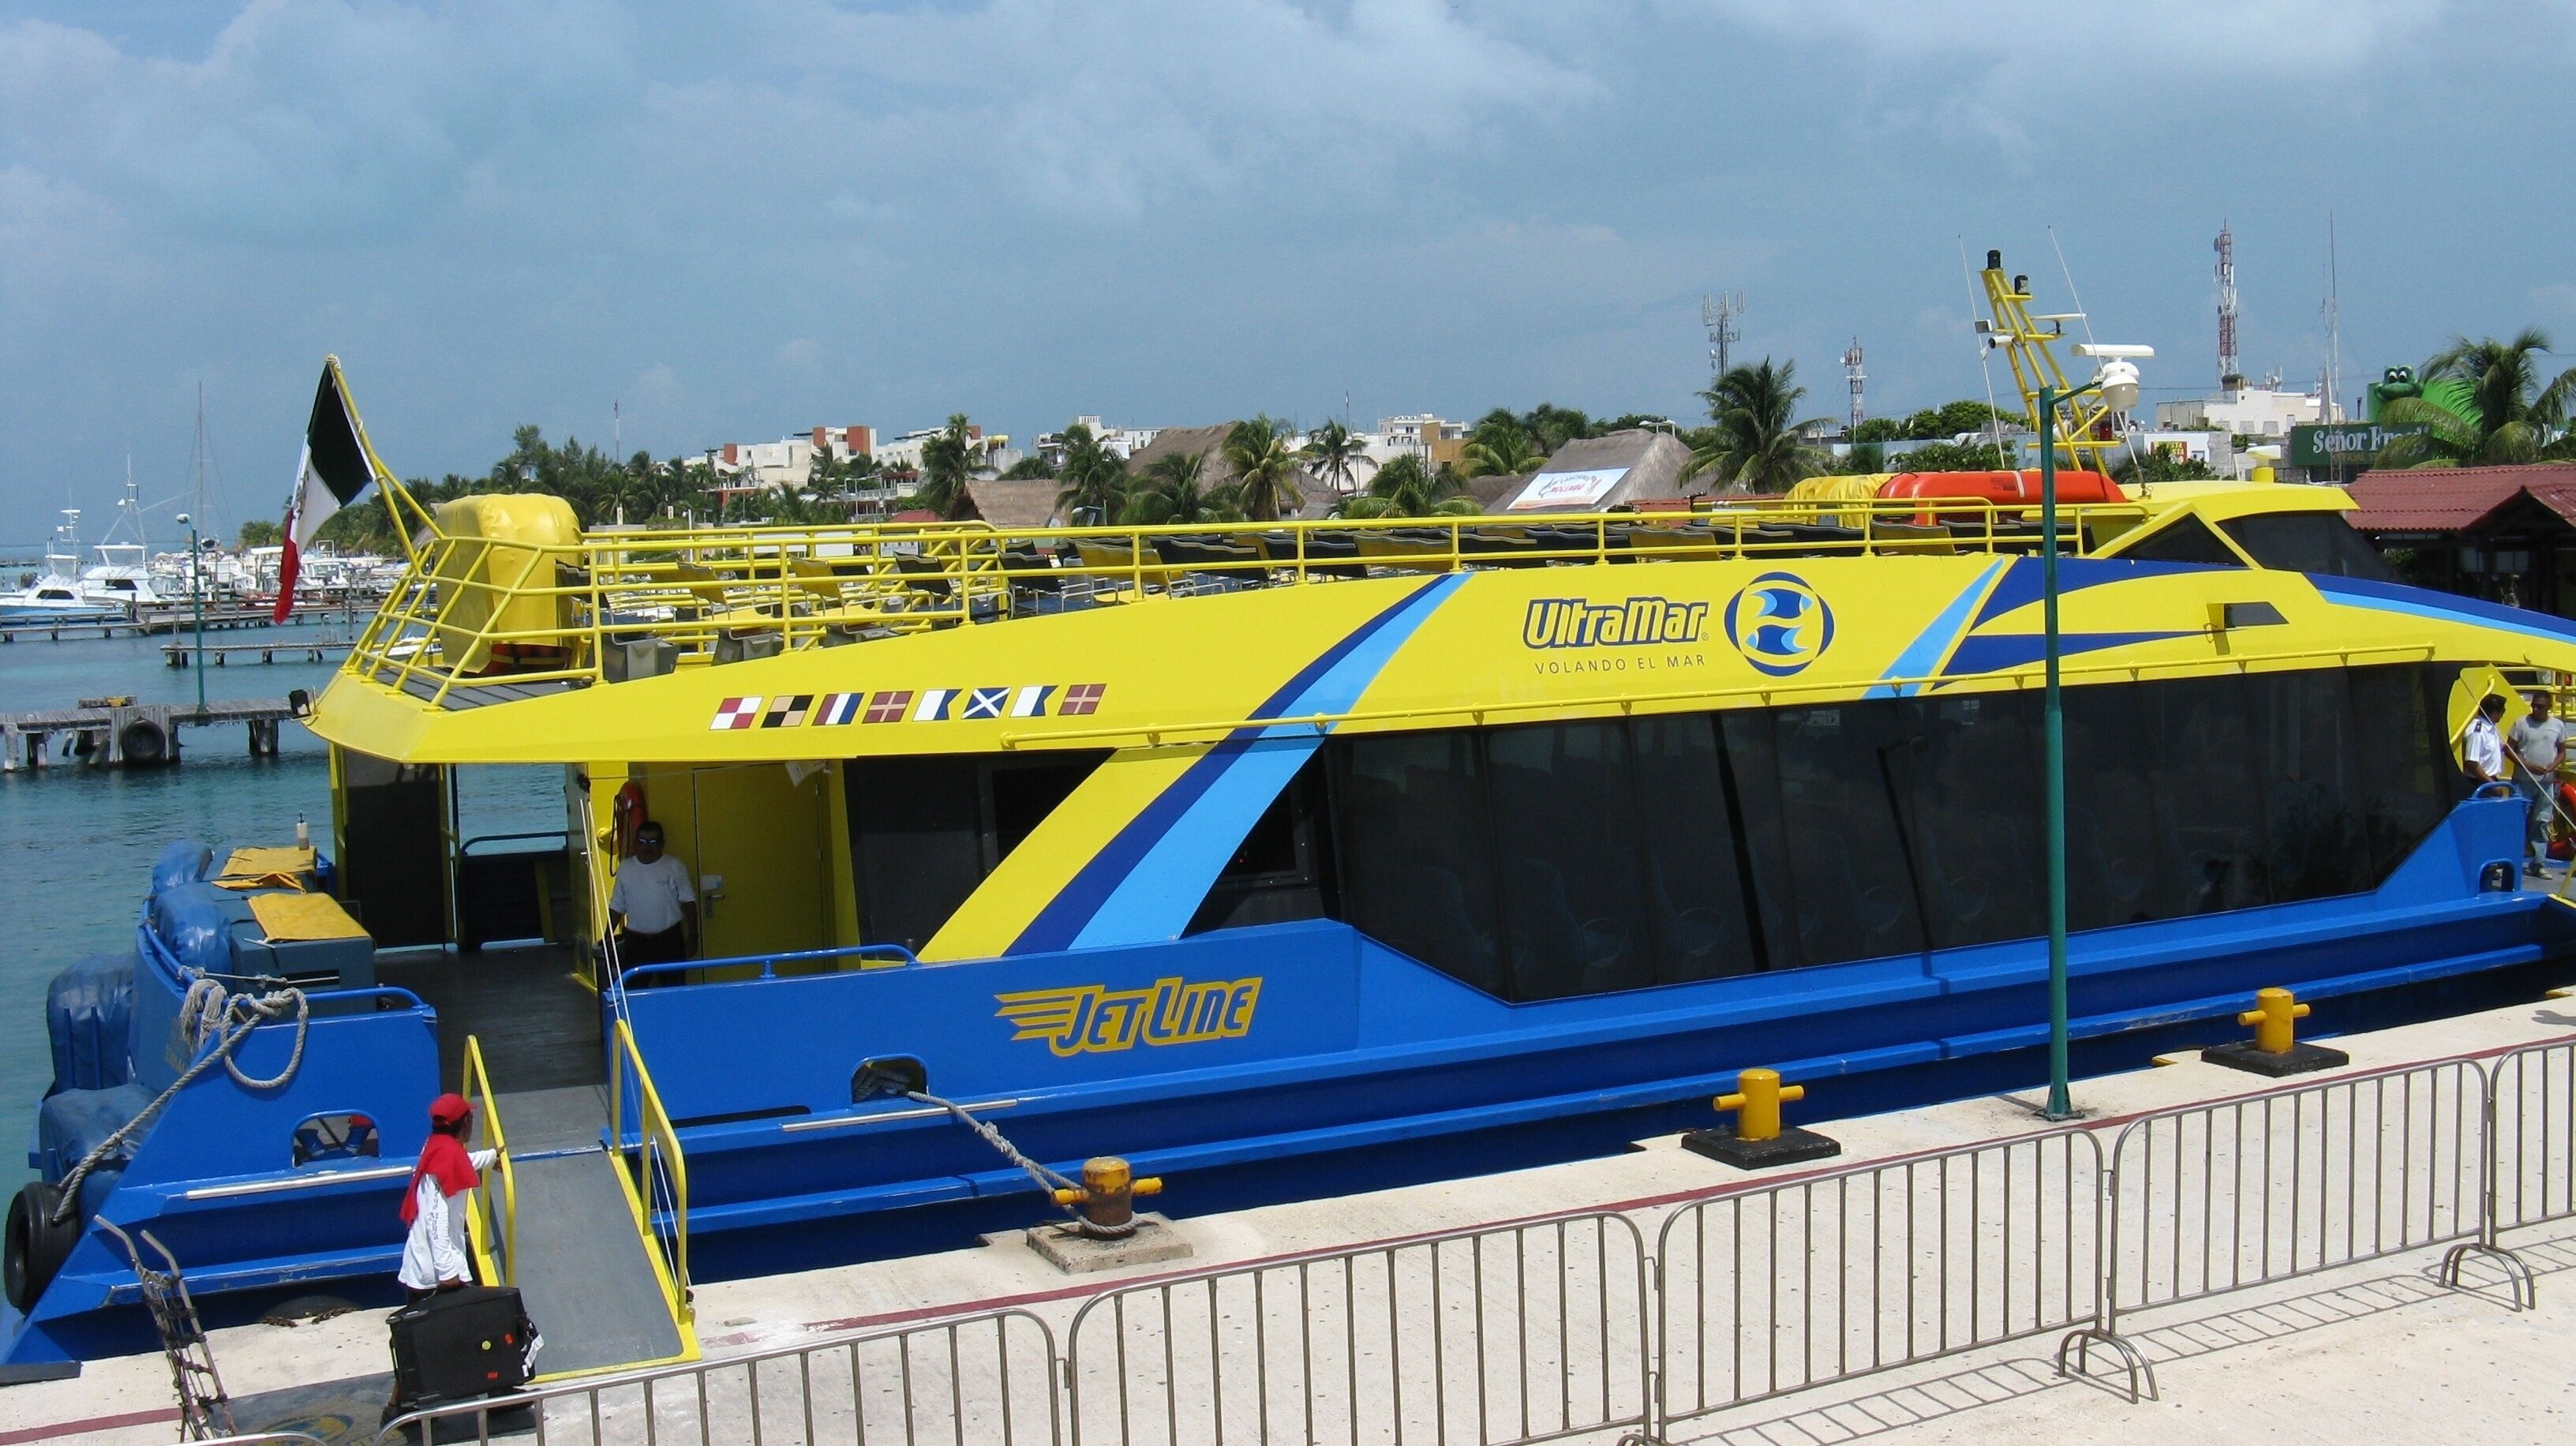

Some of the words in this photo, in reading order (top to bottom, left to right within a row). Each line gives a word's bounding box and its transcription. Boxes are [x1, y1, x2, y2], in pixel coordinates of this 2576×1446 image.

[2312, 429, 2367, 454] Señor
[1523, 597, 1709, 650] UltraMar
[1535, 658, 1626, 674] VOLANDO
[1637, 657, 1656, 669] EL
[1667, 654, 1705, 667] MAR
